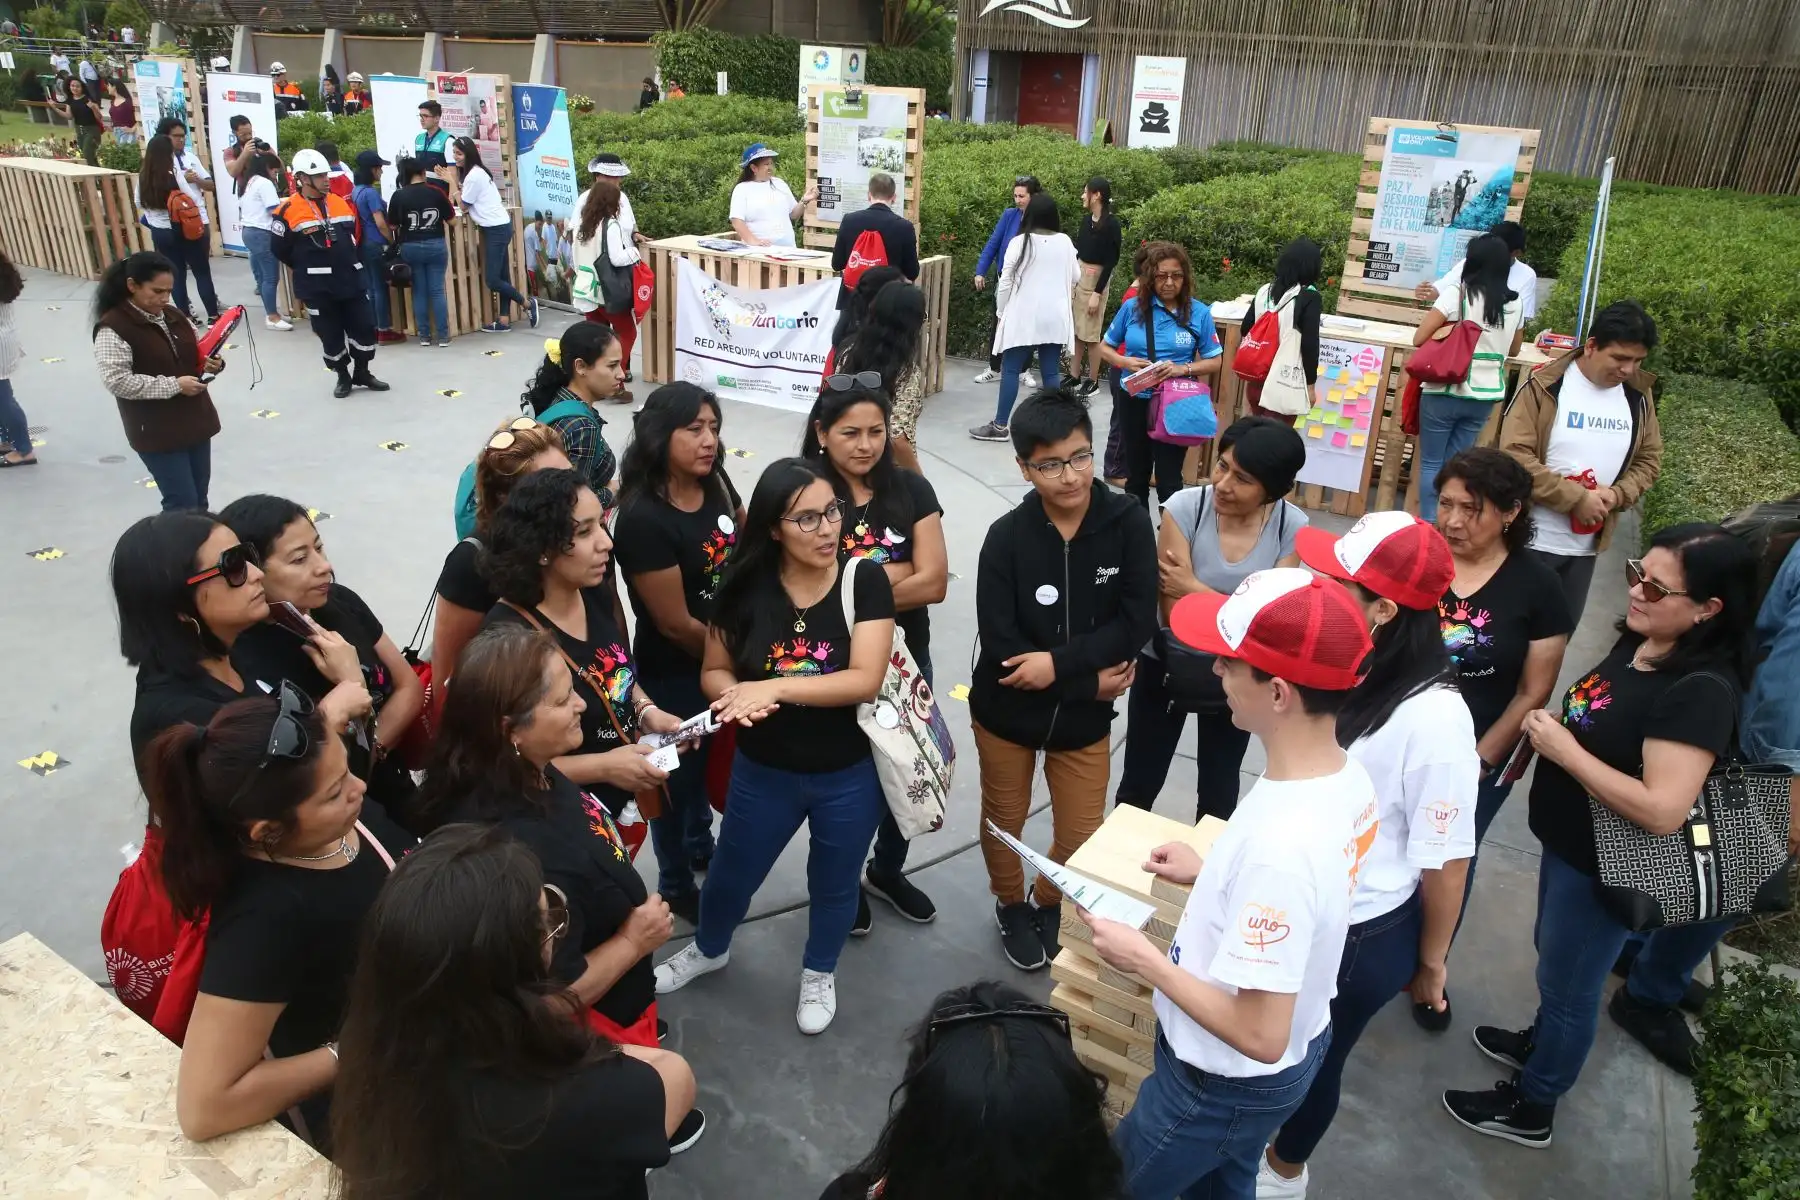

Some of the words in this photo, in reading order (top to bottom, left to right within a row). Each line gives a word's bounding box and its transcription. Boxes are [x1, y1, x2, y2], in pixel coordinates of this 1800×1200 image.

[521, 120, 539, 131] LIMA
[1386, 180, 1404, 193] PAZ
[407, 208, 440, 231] 12
[1379, 217, 1393, 230] EN
[1393, 219, 1404, 231] EL
[1372, 252, 1392, 261] HUELLA
[1370, 261, 1398, 271] QUEREMOS
[1369, 271, 1388, 280] DEJAR?
[694, 336, 715, 349] RED
[717, 342, 760, 360] AREQUIPA
[762, 351, 826, 365] VOLUNTARIA
[791, 383, 810, 392] oew
[1587, 415, 1630, 431] VAINSA
